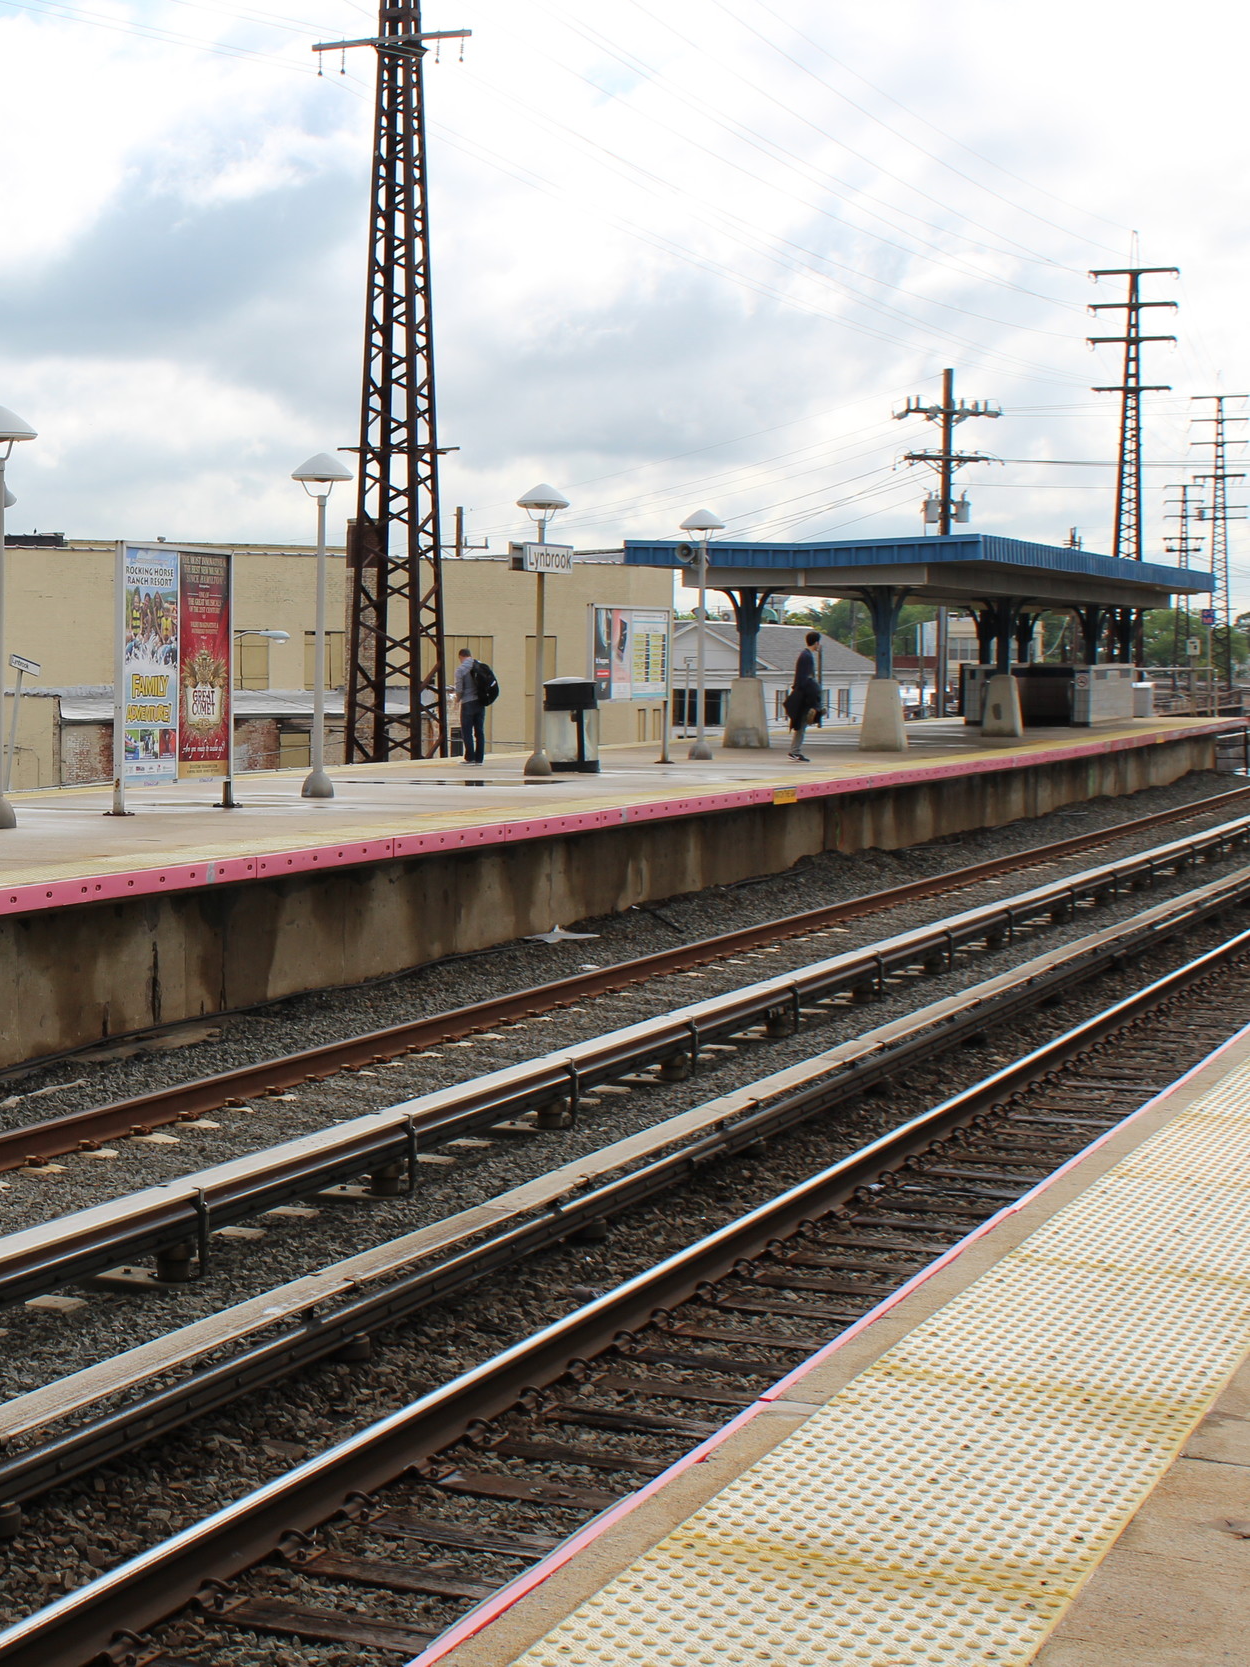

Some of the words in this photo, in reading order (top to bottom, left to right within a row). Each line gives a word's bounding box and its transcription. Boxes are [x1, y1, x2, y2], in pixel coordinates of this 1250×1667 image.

[528, 546, 571, 570] Lynbrook
[125, 566, 153, 576] ROCKING
[154, 567, 174, 577] HORSE
[127, 576, 148, 585] RANCH
[150, 578, 172, 587] RESORT
[132, 674, 169, 699] FAMILY
[192, 690, 215, 702] GREAT
[125, 703, 172, 723] ADVENTURE!
[191, 703, 215, 716] COMET
